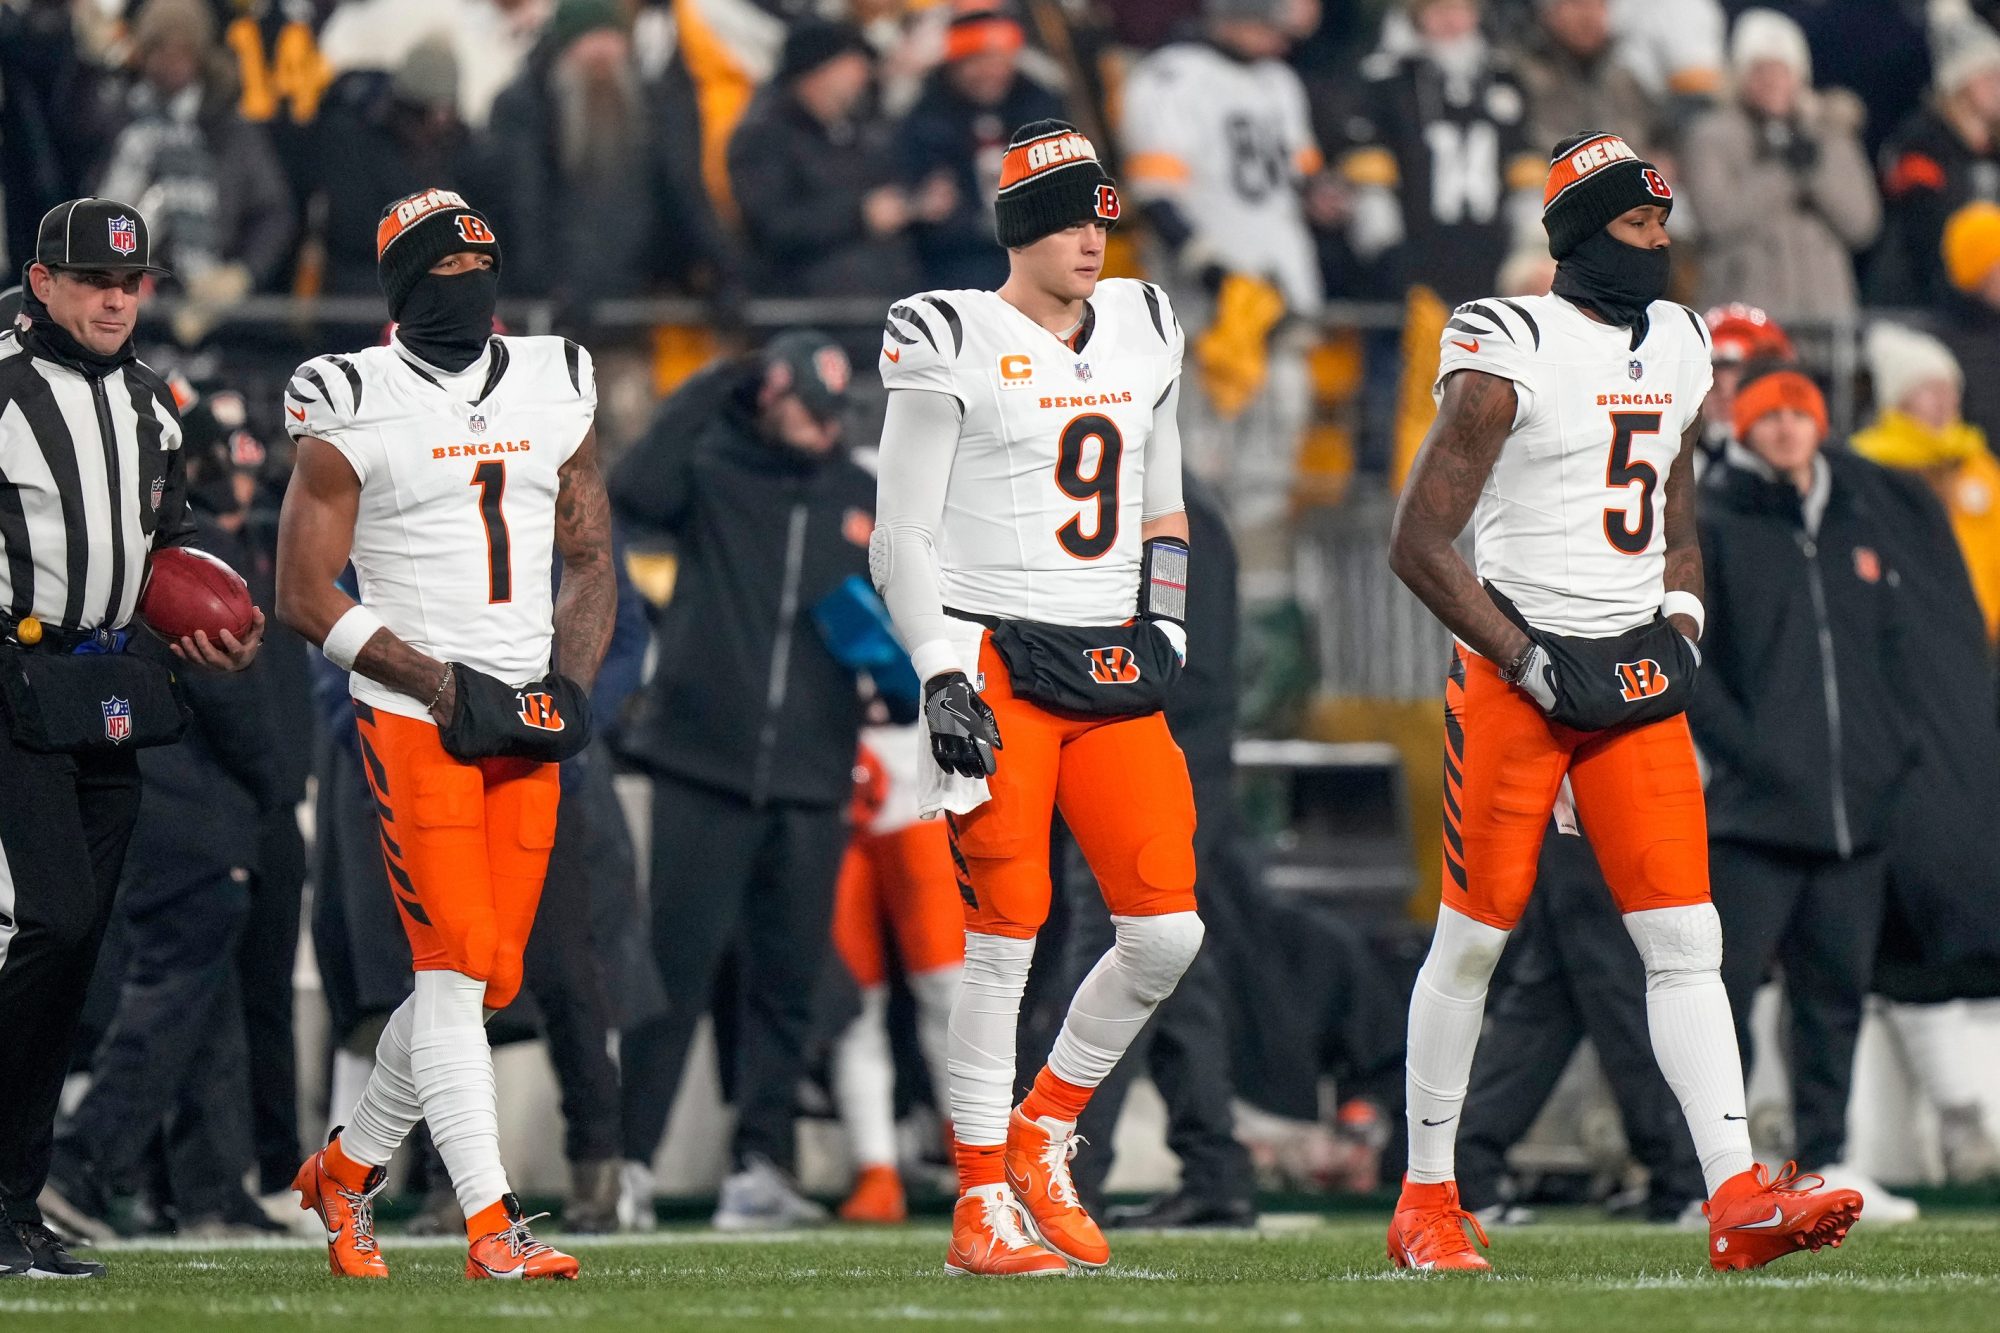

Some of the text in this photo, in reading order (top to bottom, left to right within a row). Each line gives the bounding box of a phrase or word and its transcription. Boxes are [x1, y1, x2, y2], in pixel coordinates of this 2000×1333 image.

[112, 231, 135, 251] NFL
[1000, 355, 1033, 379] C
[1039, 391, 1132, 408] BENGALS
[1597, 393, 1672, 406] BENGALS
[432, 440, 530, 459] BENGALS
[1055, 412, 1124, 561] 9
[1603, 411, 1663, 555] 5
[470, 459, 512, 604] 1
[107, 716, 129, 738] NFL
